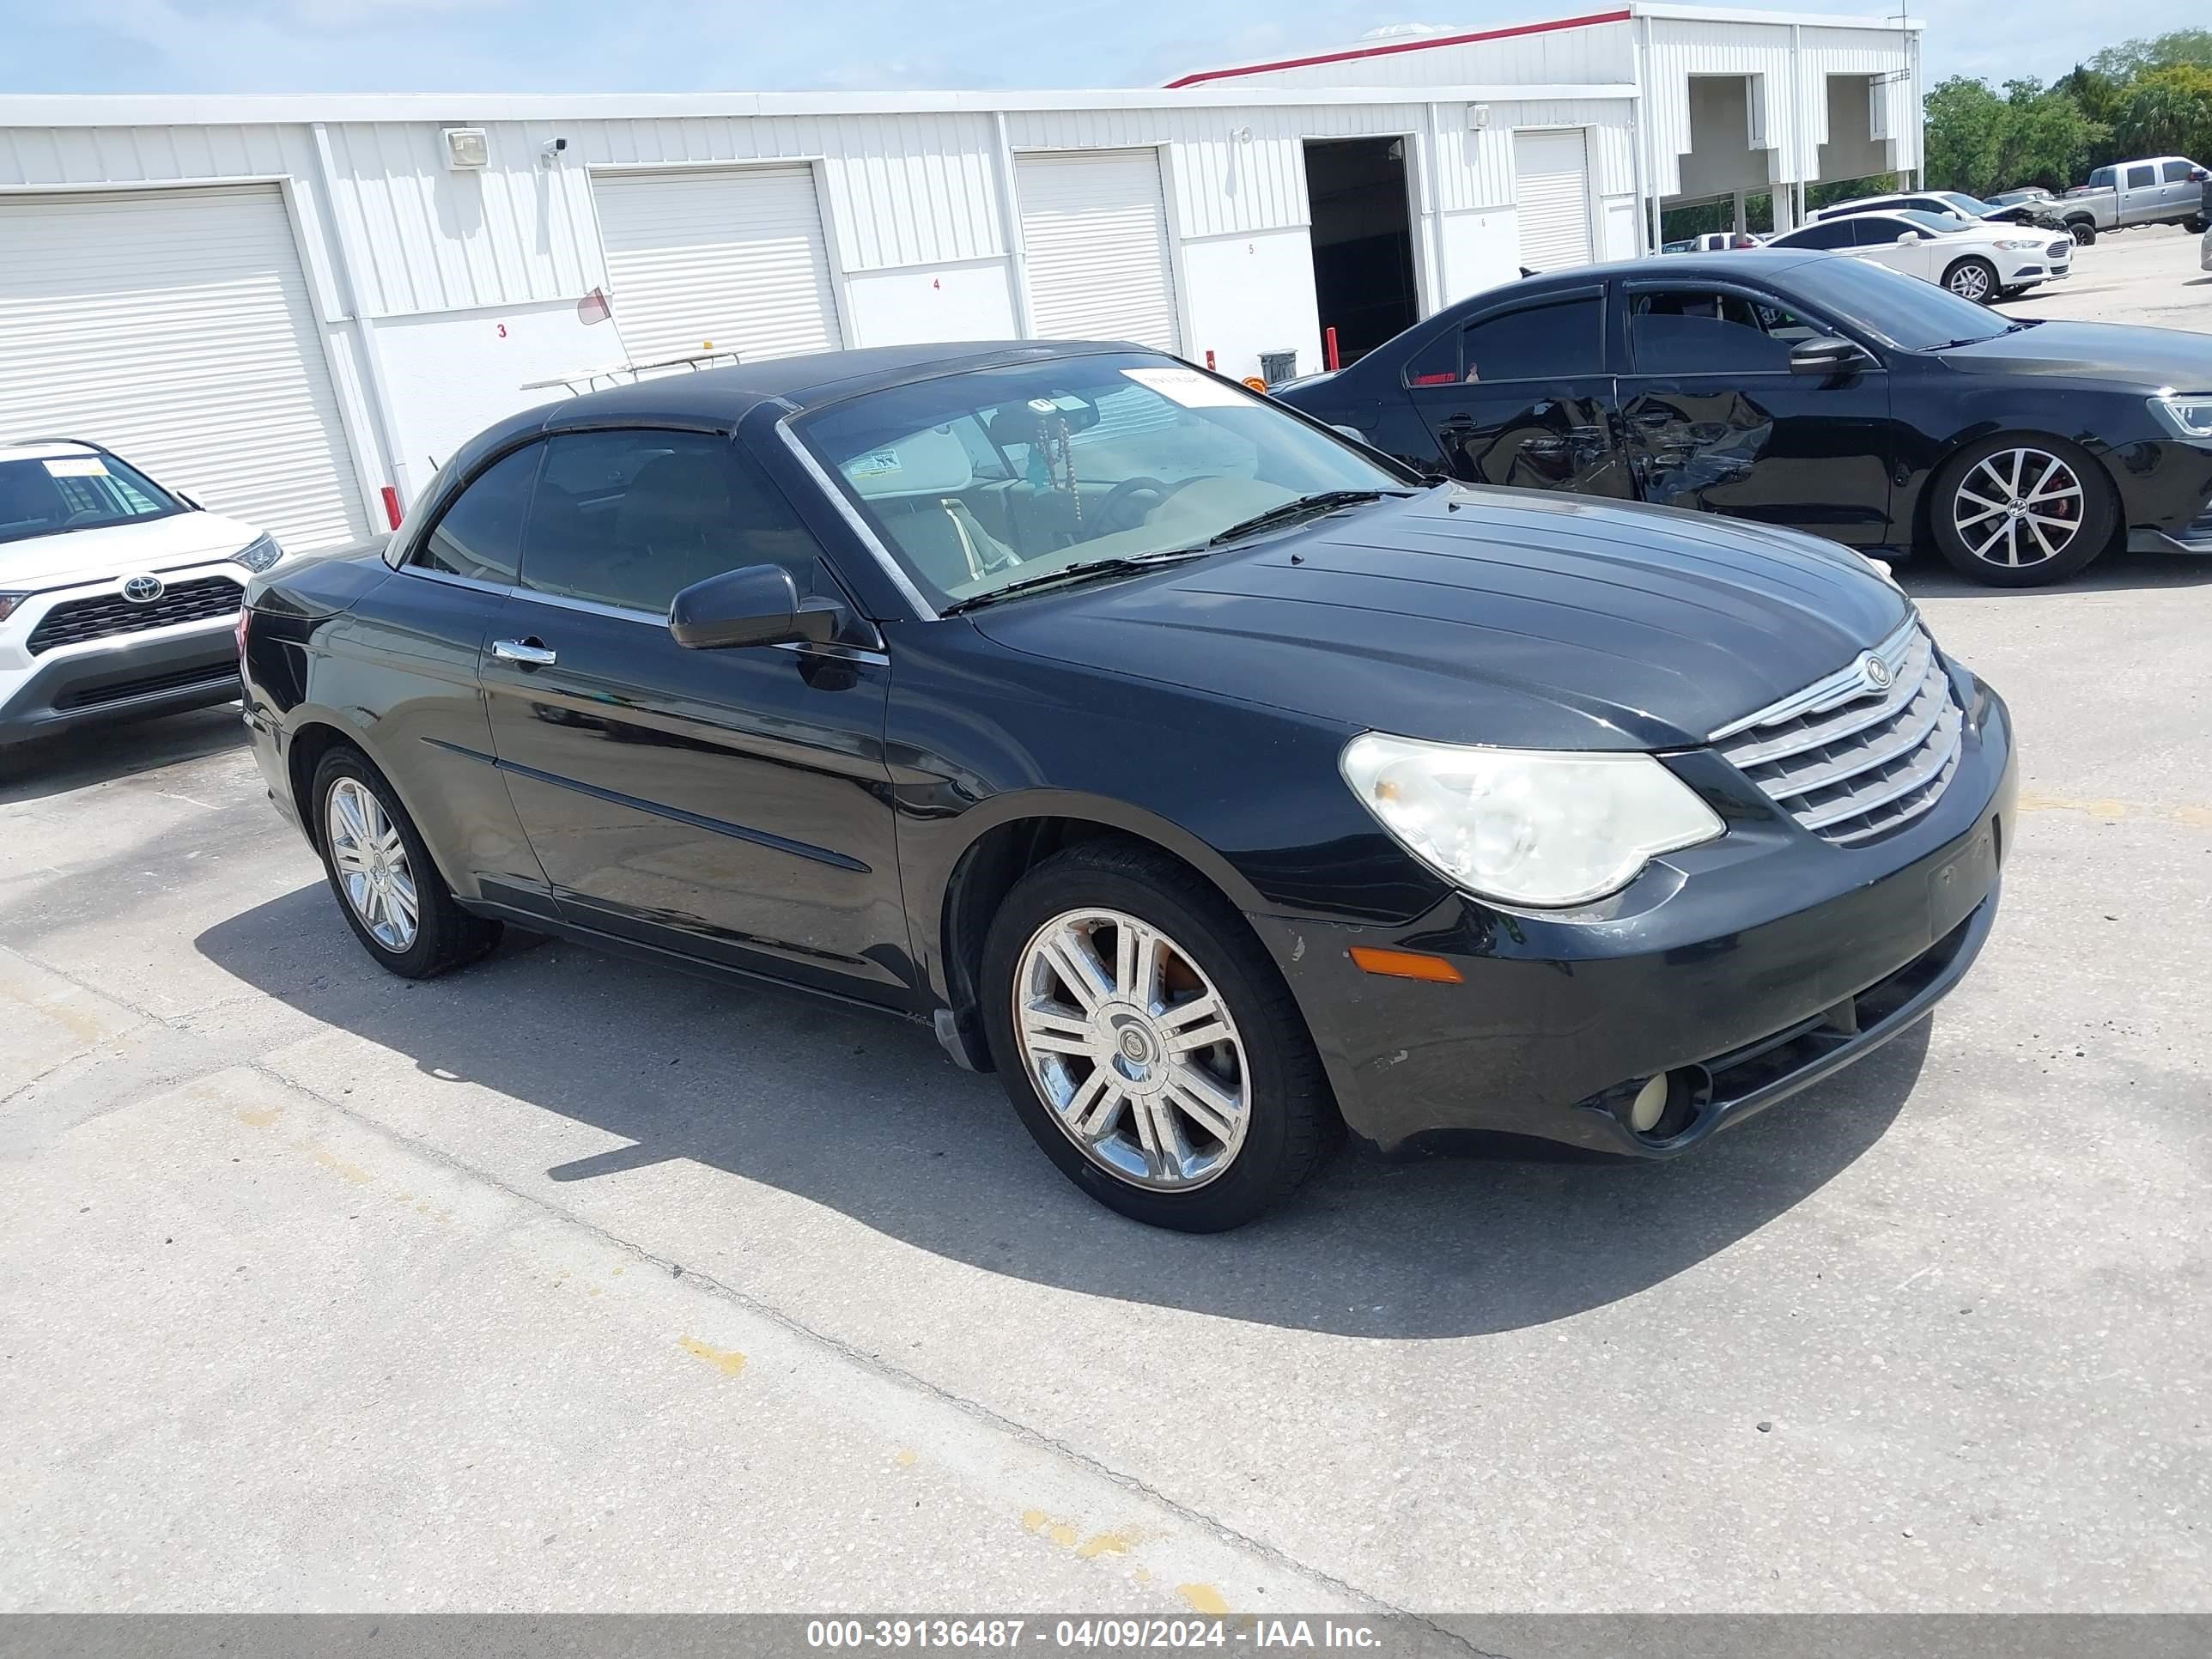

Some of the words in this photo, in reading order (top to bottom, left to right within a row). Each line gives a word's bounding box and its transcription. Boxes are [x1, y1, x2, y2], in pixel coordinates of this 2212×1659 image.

[1249, 244, 1255, 254] 5
[933, 278, 940, 291] 4
[497, 324, 507, 337] 3
